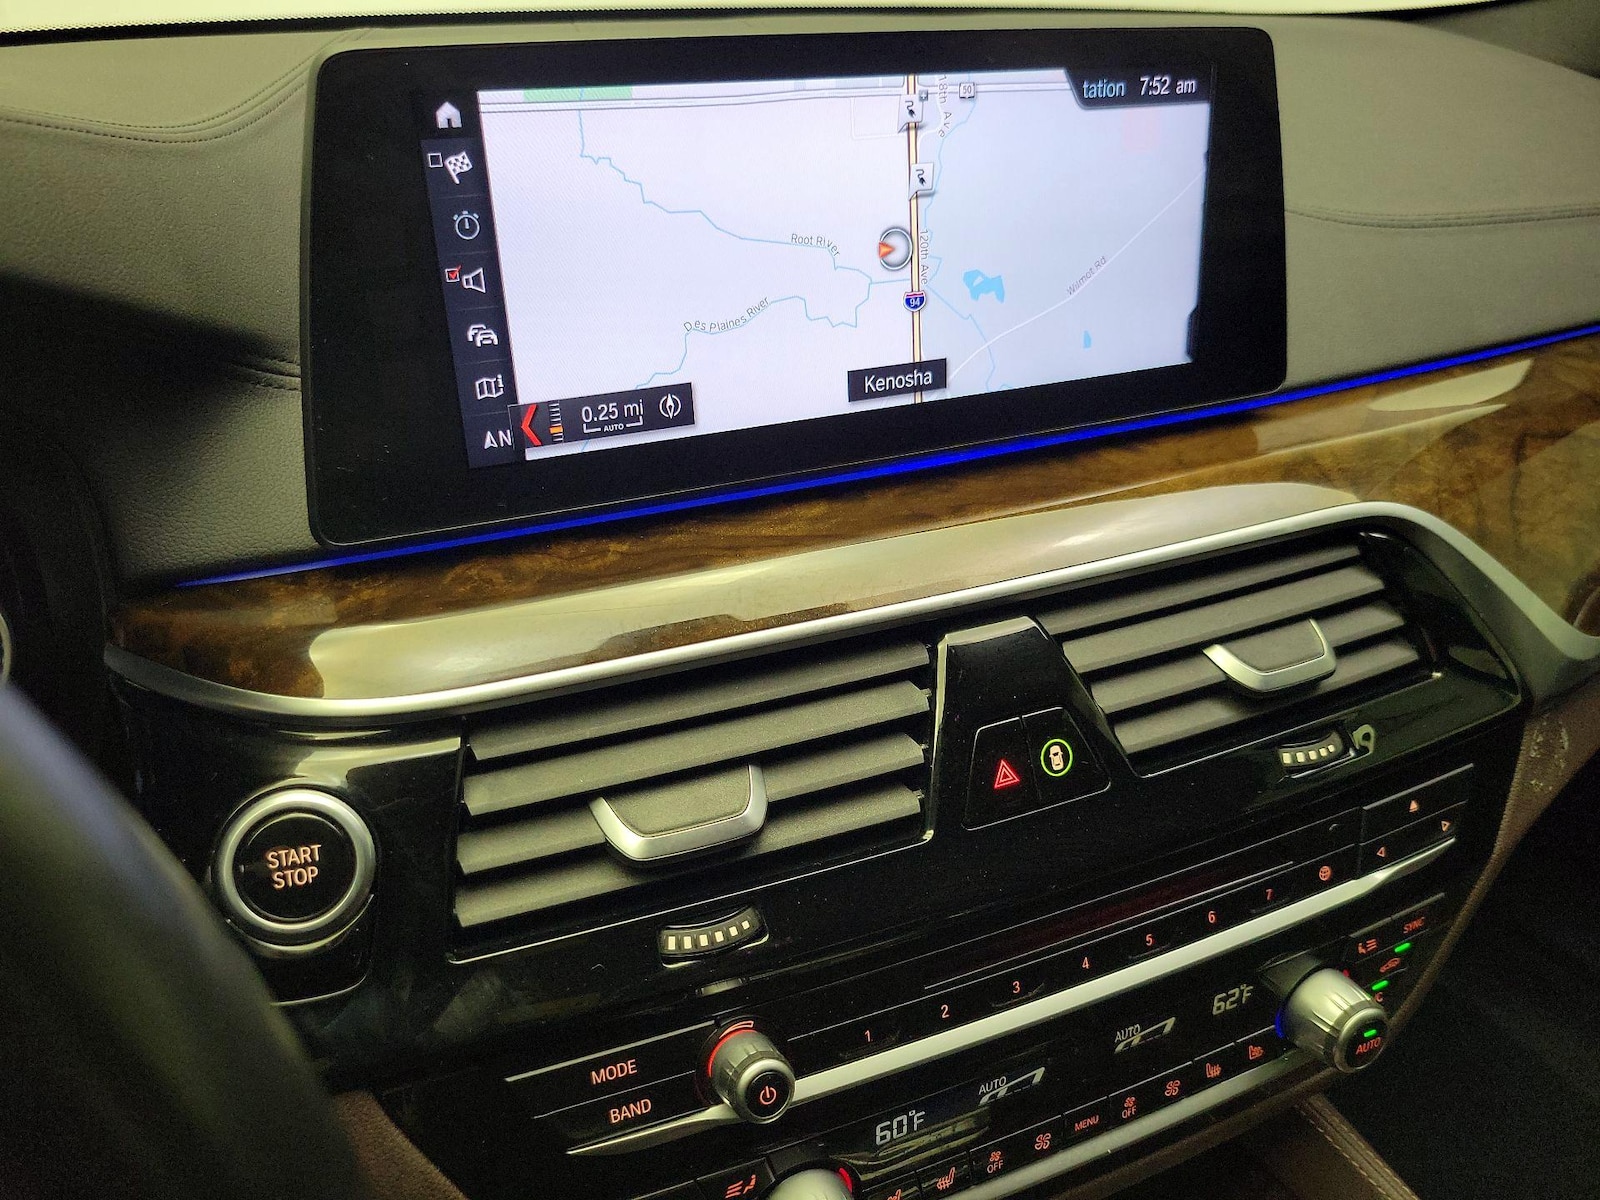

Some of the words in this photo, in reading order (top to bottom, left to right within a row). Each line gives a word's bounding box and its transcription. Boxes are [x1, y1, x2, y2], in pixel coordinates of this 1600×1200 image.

[962, 85, 972, 95] 50
[1083, 79, 1126, 98] tation
[1139, 75, 1171, 96] 7:52
[1175, 80, 1198, 95] am
[938, 111, 952, 138] Ave
[791, 233, 814, 247] Root
[816, 236, 840, 257] River
[920, 229, 929, 260] 120th
[920, 264, 929, 286] Ave
[1066, 267, 1095, 296] Wilmot
[1094, 255, 1107, 270] Rd
[909, 298, 920, 308] 94
[683, 319, 707, 333] Des
[709, 315, 748, 333] Plaines
[746, 296, 769, 318] River
[864, 368, 933, 394] Kenosha
[581, 402, 619, 423] 0.25
[624, 399, 645, 418] mi
[603, 423, 625, 433] AUTO
[266, 844, 322, 869] START
[272, 866, 319, 889] STOP
[1265, 888, 1274, 902] 7
[1207, 910, 1217, 924] 6
[1403, 916, 1426, 934] SYNC
[1145, 933, 1153, 947] 5
[1082, 956, 1090, 970] 4
[1011, 980, 1021, 994] 3
[940, 1004, 950, 1019] 2
[864, 1029, 872, 1043] 1
[1114, 1023, 1142, 1043] AUTO
[1356, 1036, 1383, 1055] AUTO
[591, 1059, 638, 1085] MODE
[978, 1075, 1007, 1095] AUTO
[609, 1098, 652, 1124] BAND
[1121, 1105, 1137, 1119] OFF
[1074, 1115, 1099, 1132] MENU
[986, 1160, 1004, 1174] OFF
